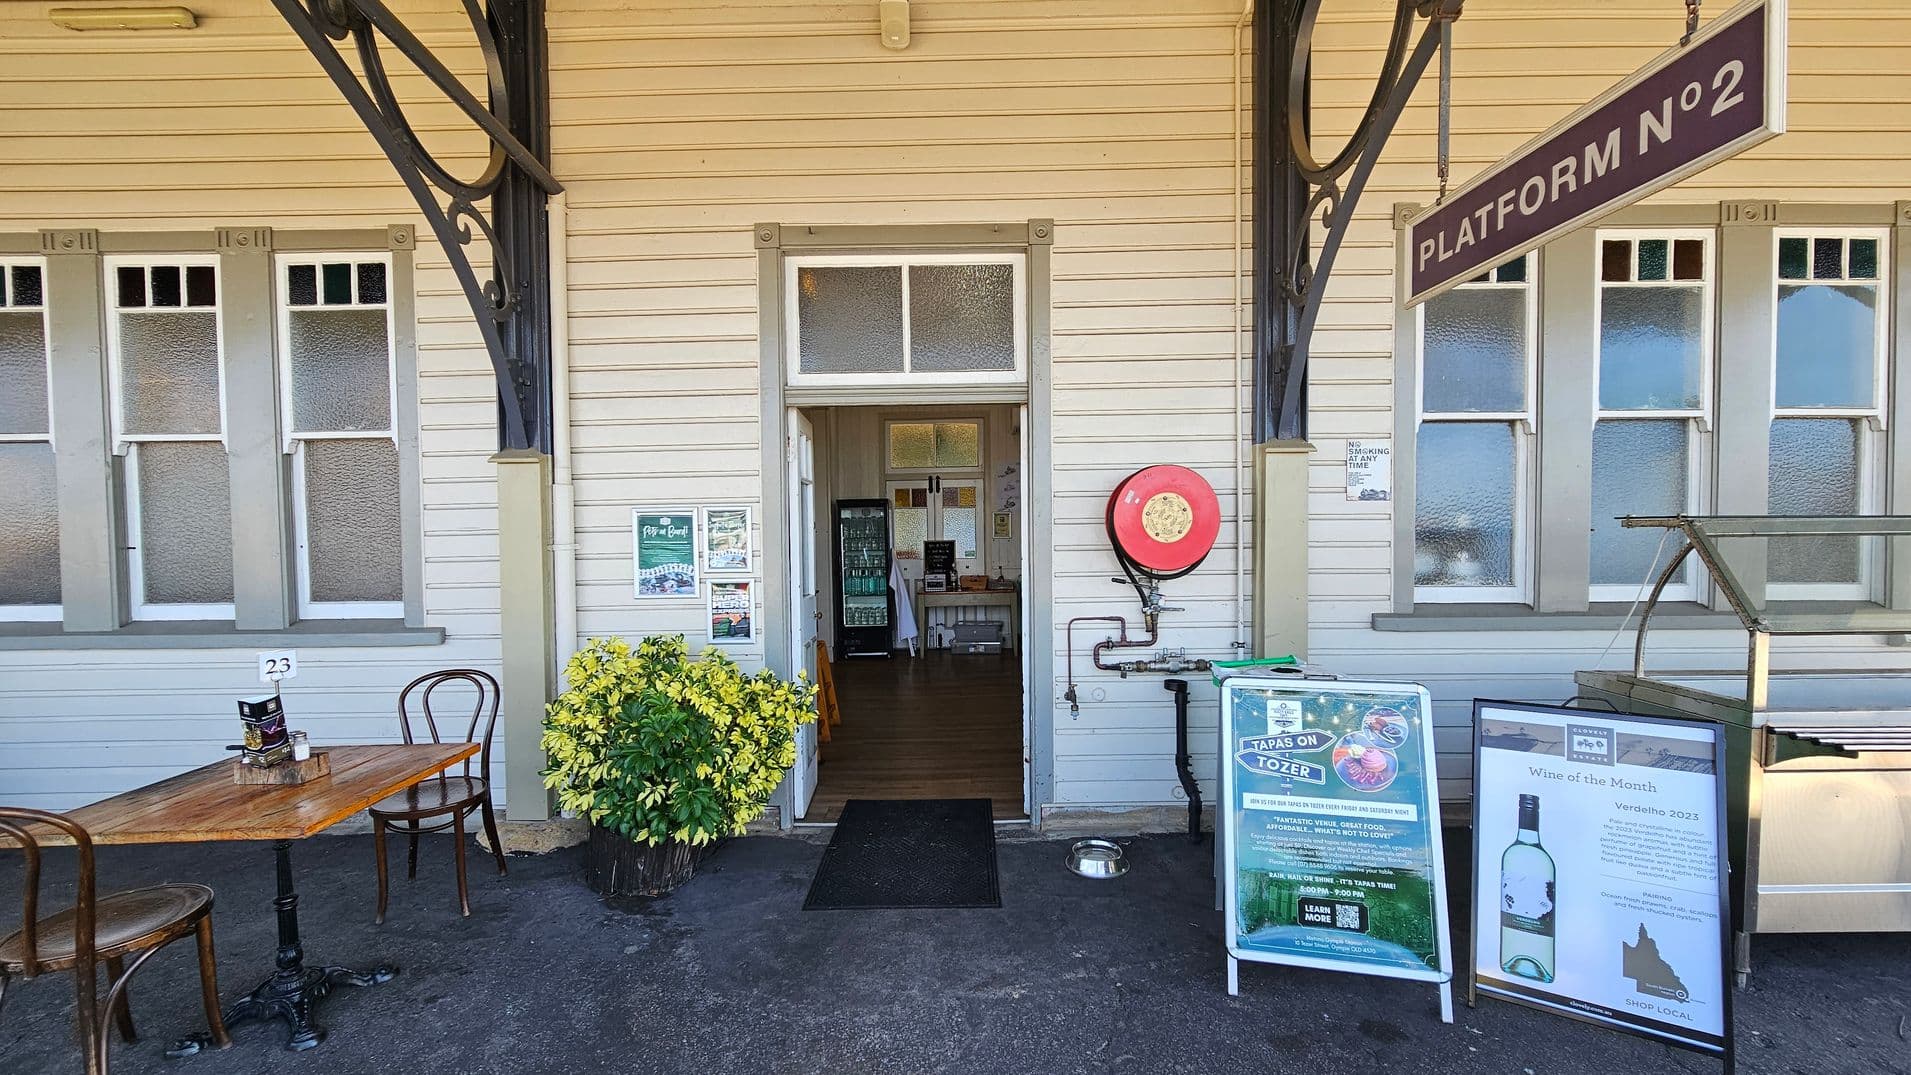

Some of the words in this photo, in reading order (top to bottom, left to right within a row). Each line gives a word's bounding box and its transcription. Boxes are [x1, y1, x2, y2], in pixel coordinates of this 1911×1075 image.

[1419, 127, 1621, 272] PLATFORM
[1711, 60, 1744, 118] 2
[712, 601, 749, 609] HERO
[265, 657, 291, 675] 23
[1572, 727, 1607, 735] CLOVELY
[1251, 738, 1294, 751] TAPAS
[1297, 734, 1318, 746] ON
[1573, 754, 1608, 762] ESTATE
[1256, 756, 1310, 778] TOZER
[1528, 766, 1563, 780] Wine
[1567, 771, 1580, 782] of
[1583, 773, 1605, 786] the
[1610, 777, 1656, 793] Month
[1369, 806, 1393, 814] SATURDAY
[1615, 801, 1665, 816] Verdelho
[1669, 809, 1698, 821] 2023
[1340, 821, 1362, 829] GREAT
[1317, 887, 1329, 895] PM
[1334, 888, 1351, 897] 9:00
[1352, 890, 1364, 898] PM
[1600, 891, 1621, 900] Ocean
[1623, 895, 1639, 903] fresh
[1642, 891, 1672, 902] PAIRING
[1304, 904, 1330, 914] LEARN
[1627, 903, 1644, 911] fresh
[1646, 907, 1674, 917] shucked
[1304, 913, 1331, 923] MORE
[1625, 998, 1654, 1011] SHOP
[1657, 1005, 1693, 1021] LOCAL
